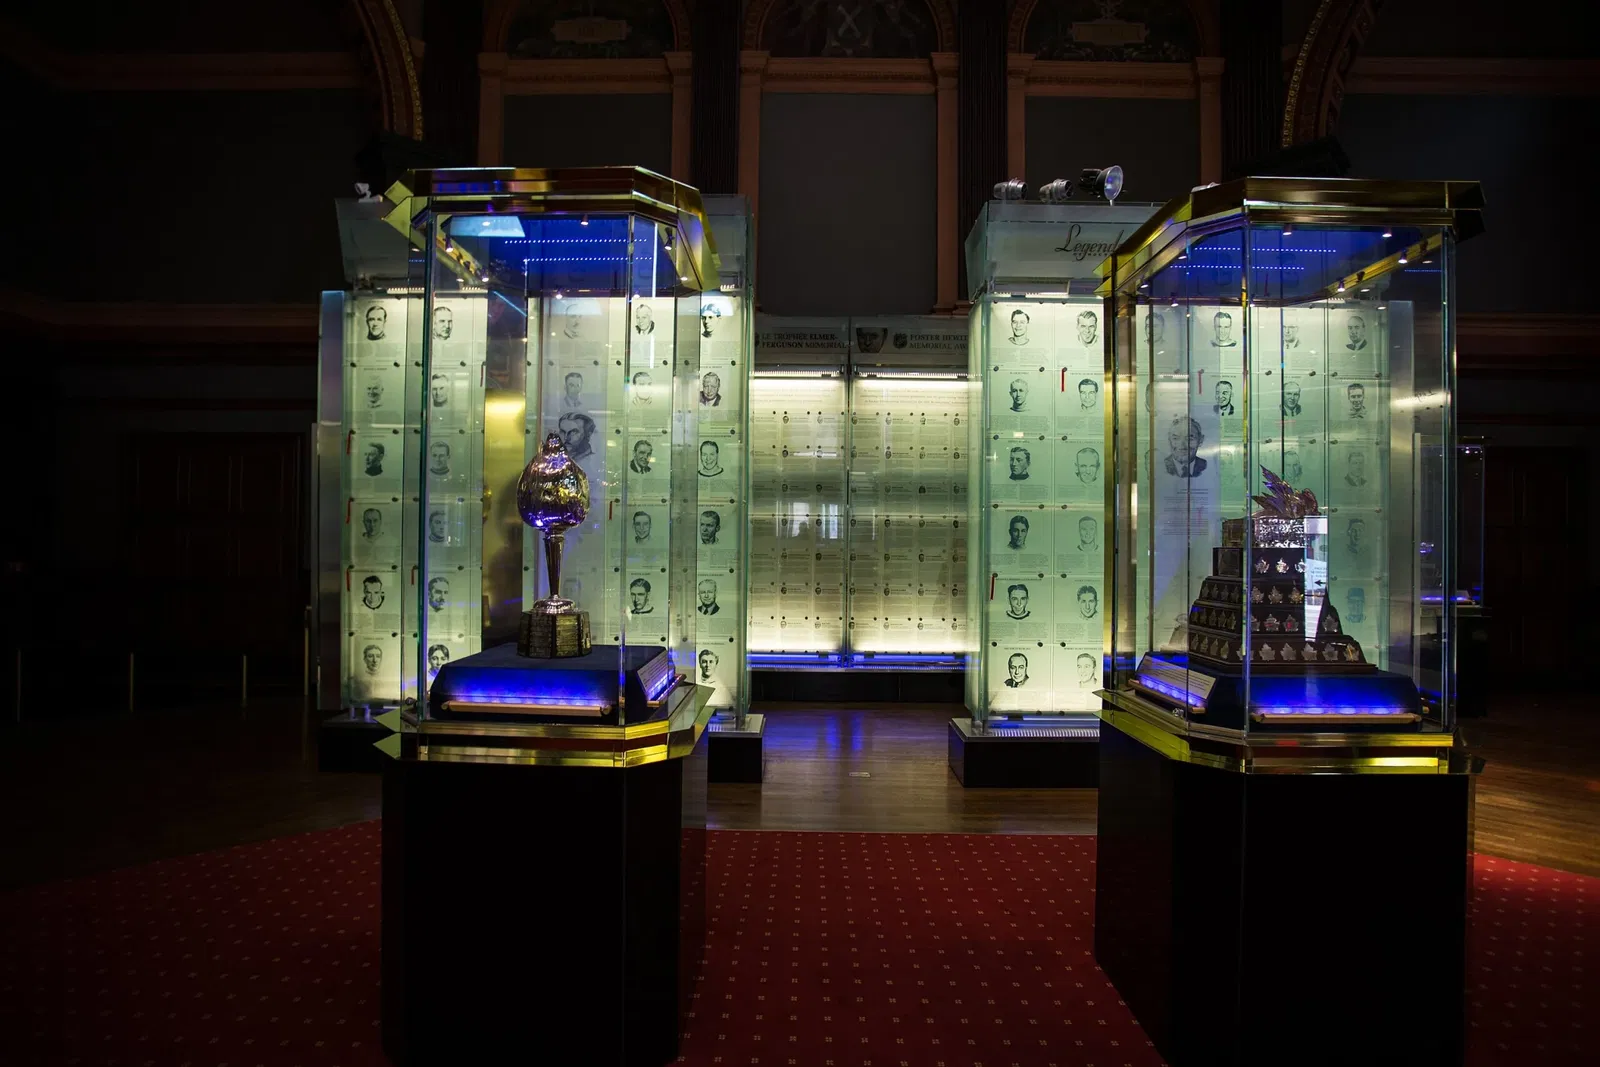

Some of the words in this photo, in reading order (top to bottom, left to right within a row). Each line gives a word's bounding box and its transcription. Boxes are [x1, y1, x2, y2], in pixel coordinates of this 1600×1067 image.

[1055, 224, 1124, 261] Legend
[910, 333, 940, 341] FOSTER
[942, 333, 968, 341] HEWIT
[804, 341, 847, 349] MEMORIAL
[909, 341, 952, 350] MEMORIAL
